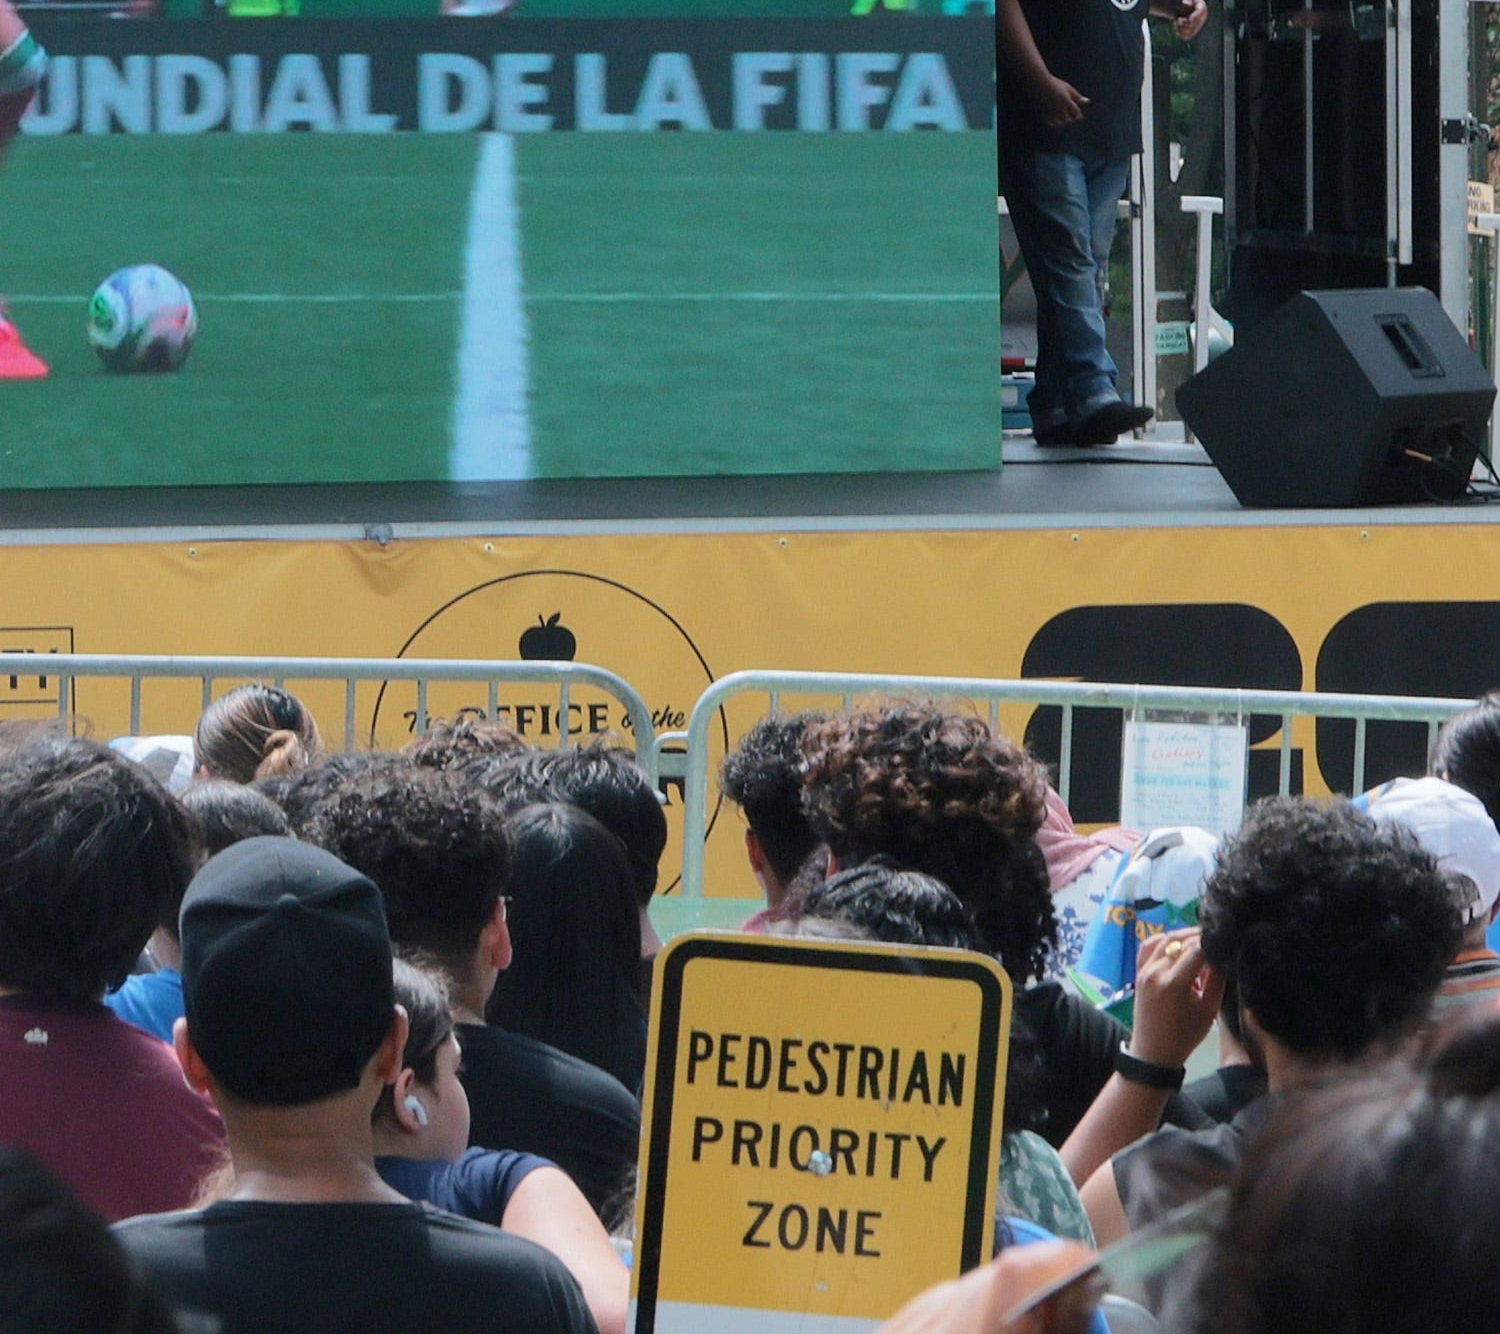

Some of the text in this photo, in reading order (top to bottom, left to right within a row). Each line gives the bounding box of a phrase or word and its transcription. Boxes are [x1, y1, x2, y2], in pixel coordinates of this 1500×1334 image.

[20, 53, 398, 137] UNDIAL
[415, 53, 553, 133] DE
[575, 53, 709, 133] LA
[732, 51, 965, 133] FIFA
[686, 1031, 966, 1107] PEDESTRIAN
[691, 1116, 947, 1182] PRIORITY
[742, 1200, 882, 1258] ZONE
